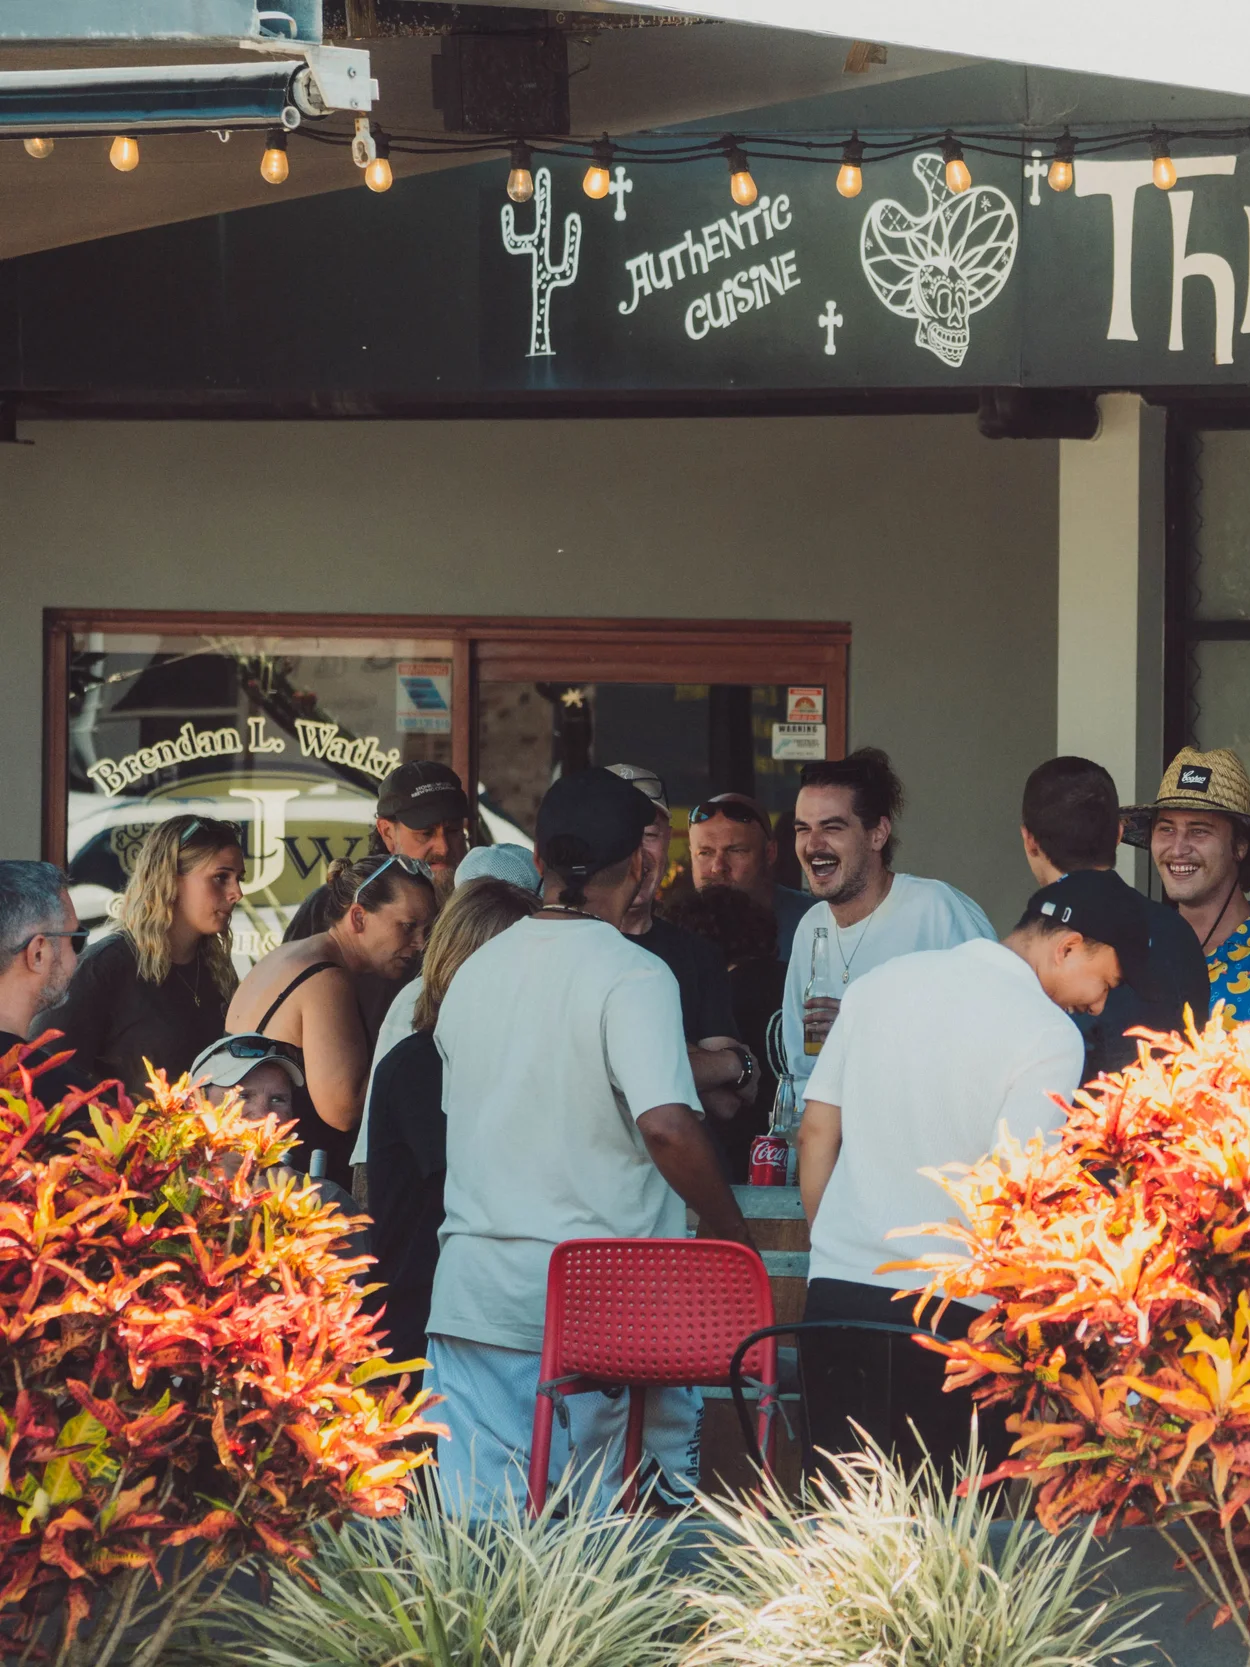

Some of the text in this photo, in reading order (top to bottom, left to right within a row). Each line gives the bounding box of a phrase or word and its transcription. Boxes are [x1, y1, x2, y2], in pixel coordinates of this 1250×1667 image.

[87, 717, 402, 798] Brendan L. Watki
[752, 1141, 784, 1166] Coca
